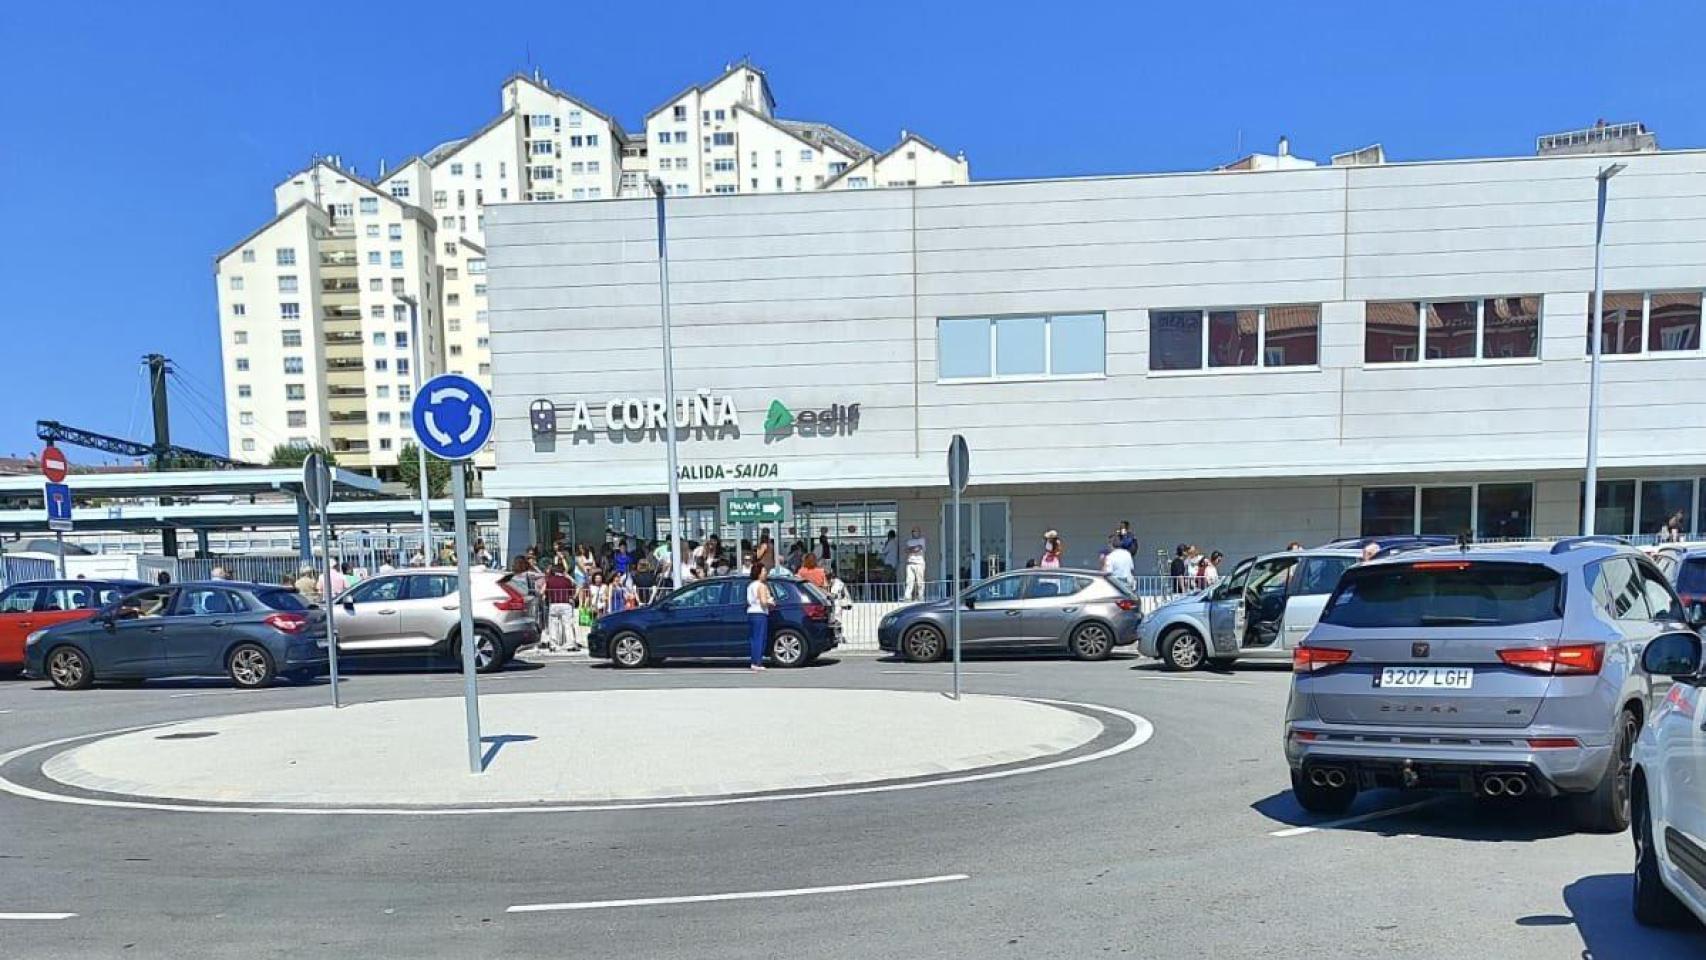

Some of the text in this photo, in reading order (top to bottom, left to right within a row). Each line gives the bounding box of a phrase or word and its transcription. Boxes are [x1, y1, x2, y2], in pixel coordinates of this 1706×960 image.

[571, 388, 740, 431] A CORUÑA
[797, 403, 861, 423] adif
[1384, 669, 1468, 686] 3207 LGH
